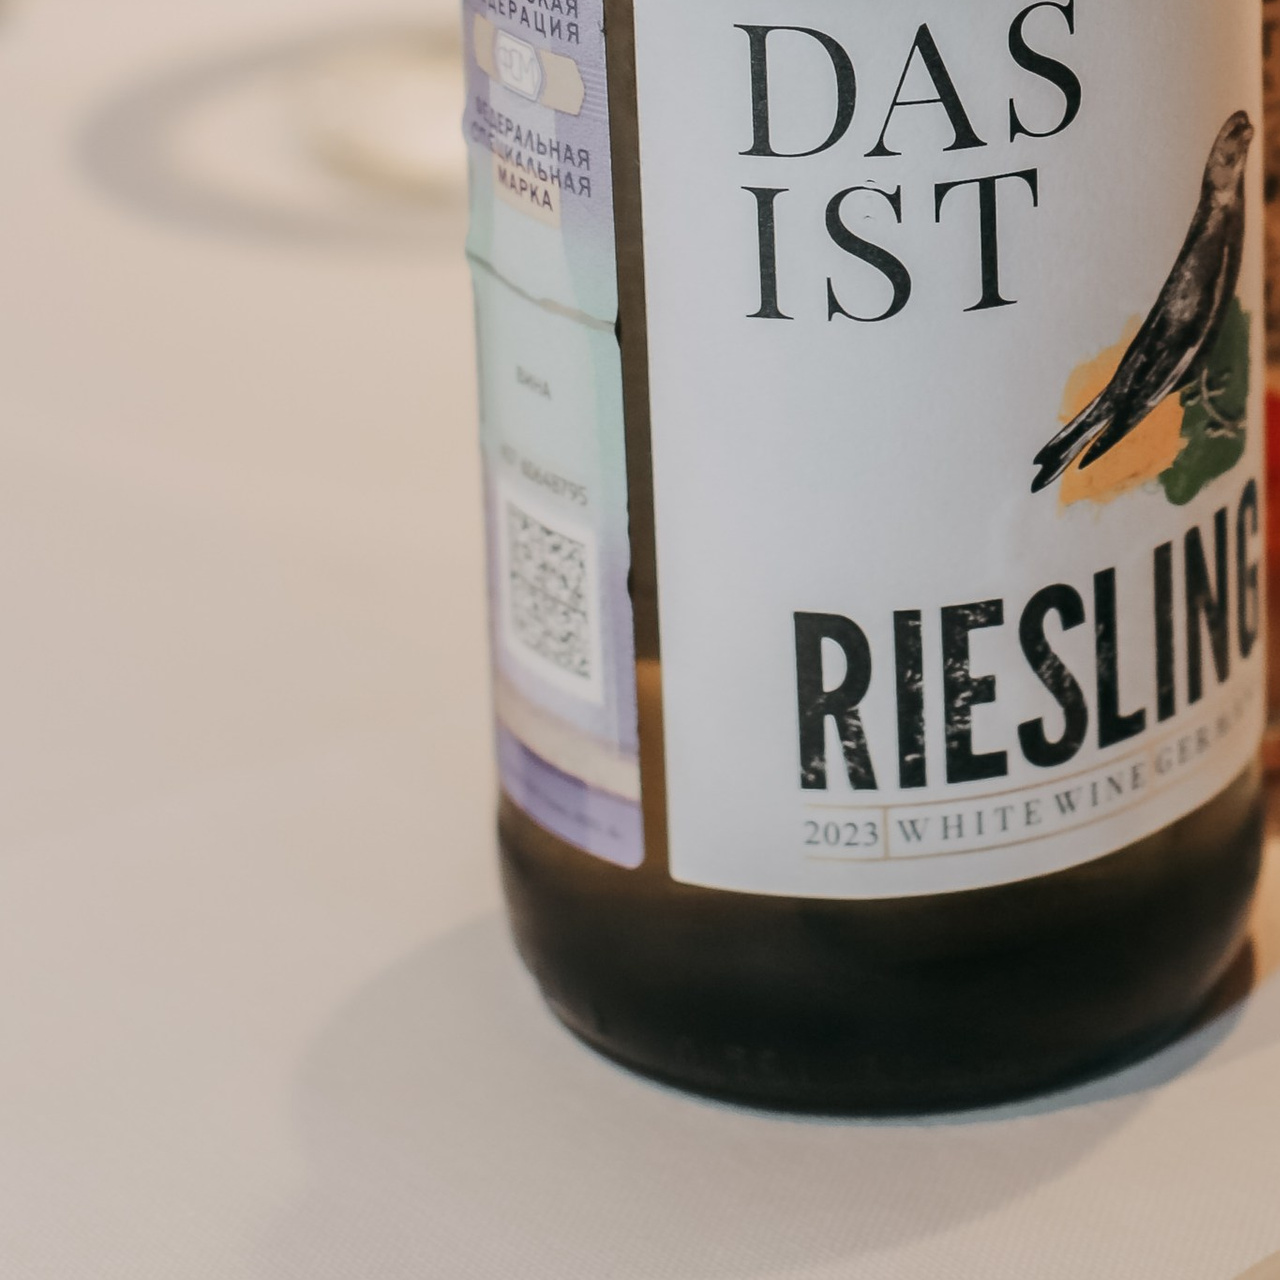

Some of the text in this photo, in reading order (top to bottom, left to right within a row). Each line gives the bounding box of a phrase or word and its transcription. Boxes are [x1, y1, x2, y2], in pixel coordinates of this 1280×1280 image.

[497, 164, 554, 213] МАРКА
[740, 168, 1039, 323] IST
[792, 477, 1260, 792] RIESLING
[803, 819, 880, 848] 2023
[896, 799, 1044, 844] WHITE
[1053, 761, 1147, 818] WINE
